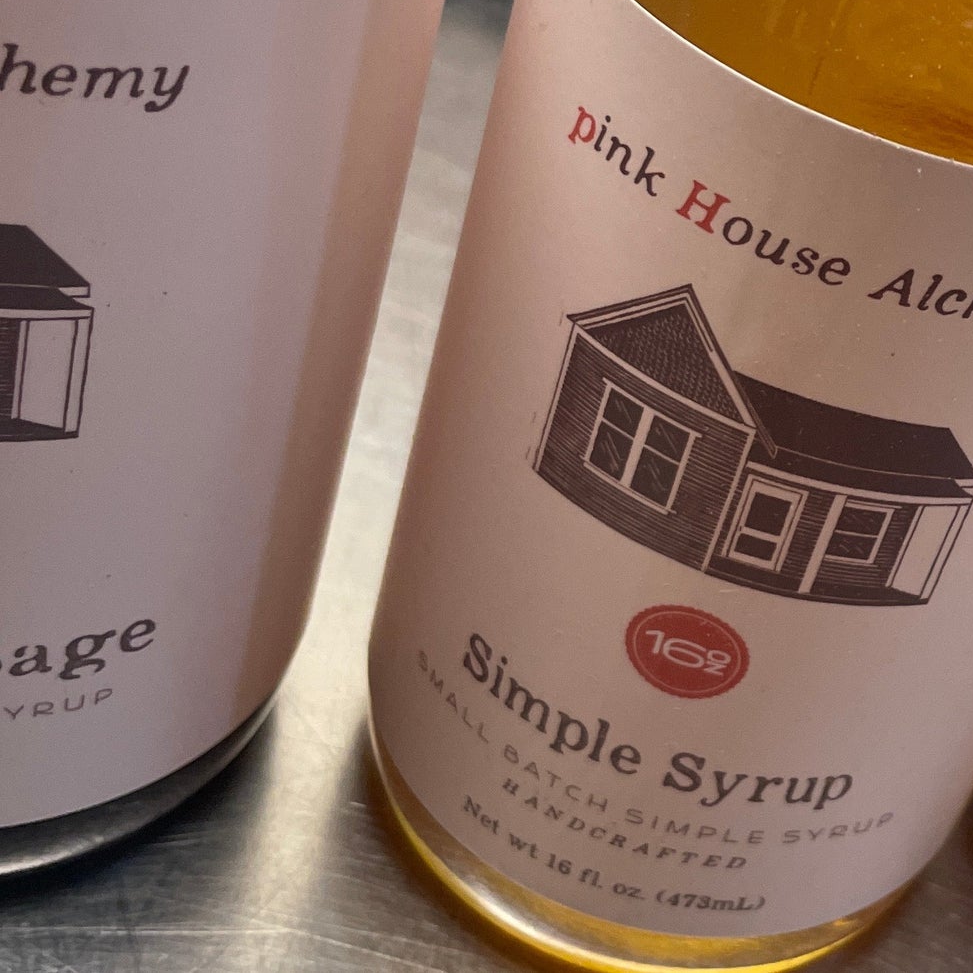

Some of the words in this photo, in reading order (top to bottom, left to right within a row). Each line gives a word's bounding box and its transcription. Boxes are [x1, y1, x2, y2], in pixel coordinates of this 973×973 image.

[568, 106, 666, 197] pink
[675, 180, 852, 287] House
[0, 618, 157, 680] age
[463, 633, 642, 775] Simple
[663, 752, 853, 811] Syrup
[418, 650, 489, 744] SMALL
[503, 744, 608, 813] BATCH
[625, 808, 765, 844] SIMPLE
[782, 811, 895, 845] SYRUP
[463, 794, 500, 835] Net
[508, 832, 539, 860] wt
[546, 853, 573, 875] 16
[655, 889, 766, 913] (473mL)
[502, 777, 748, 869] HANDCRAFTED
